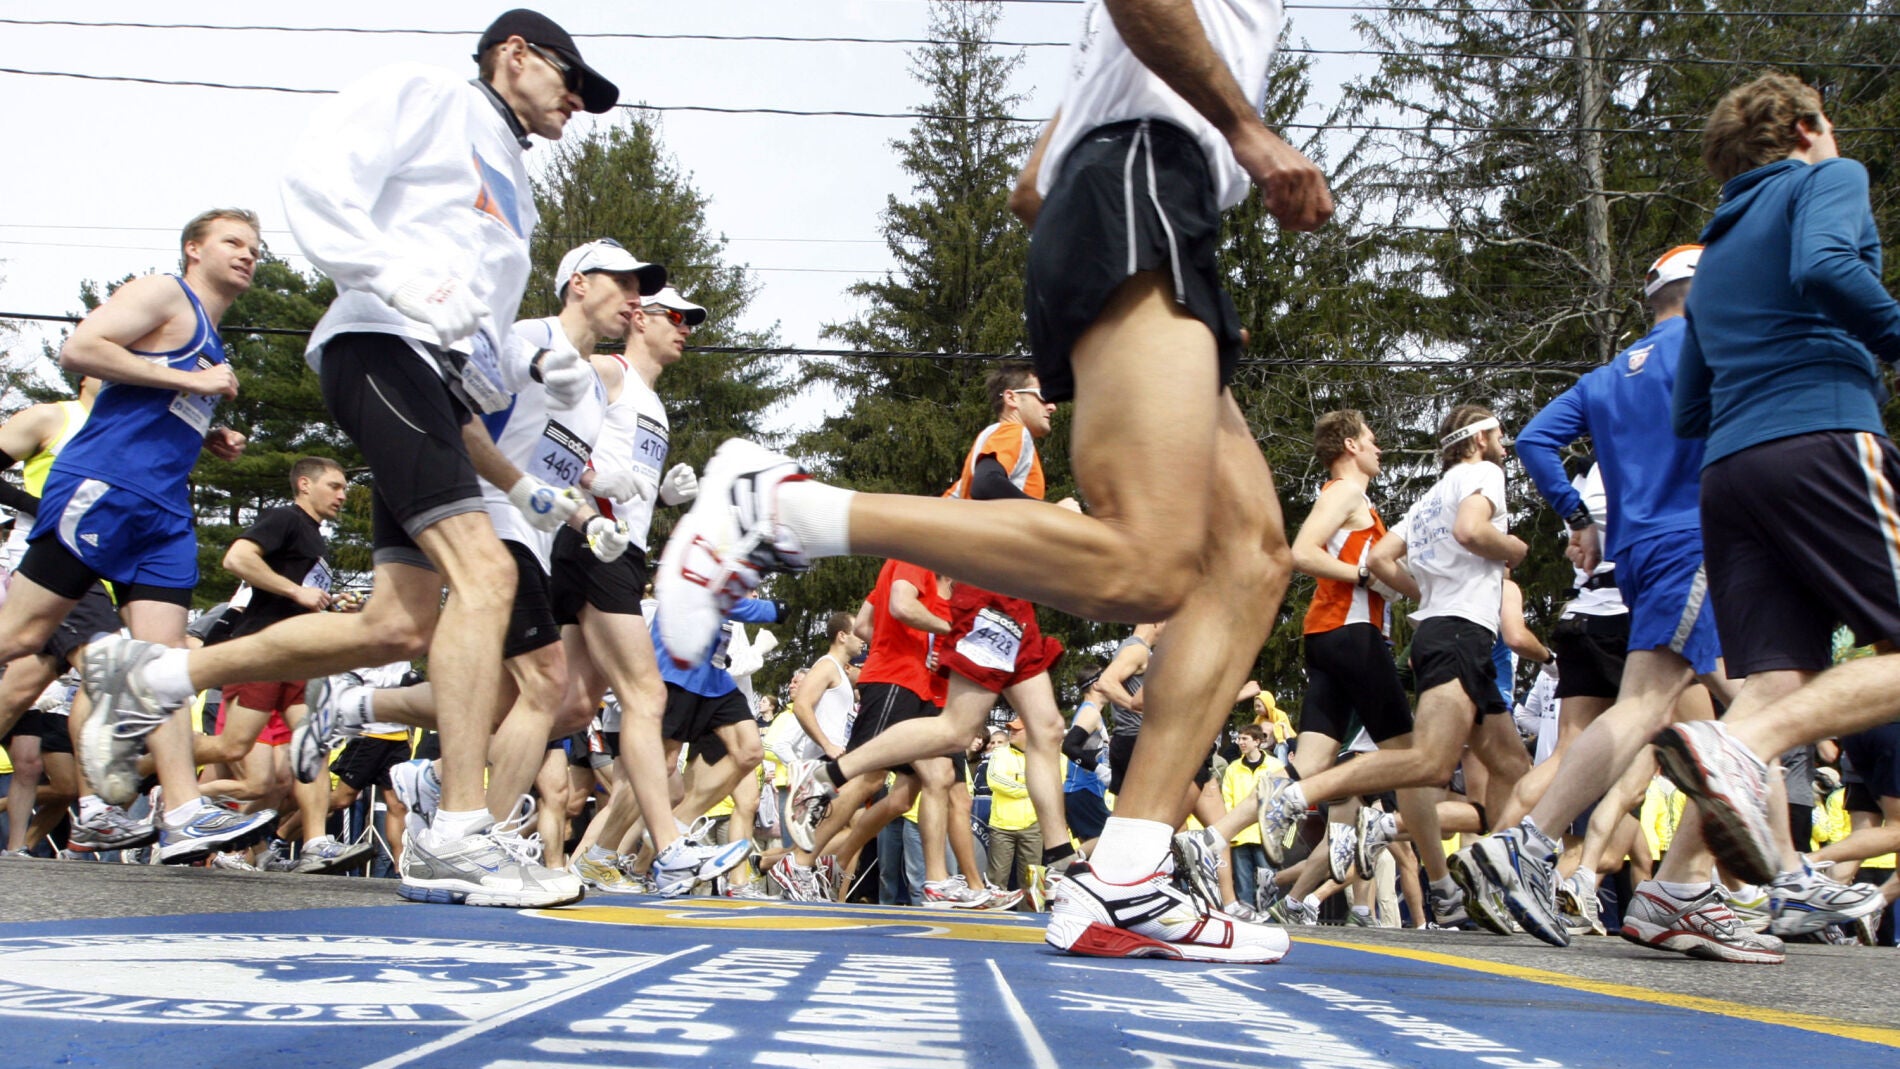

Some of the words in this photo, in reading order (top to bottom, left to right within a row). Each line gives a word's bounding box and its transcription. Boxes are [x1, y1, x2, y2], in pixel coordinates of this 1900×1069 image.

[637, 947, 823, 1001] BOSTON
[1324, 1003, 1407, 1014] is
[1364, 1013, 1523, 1053] future
